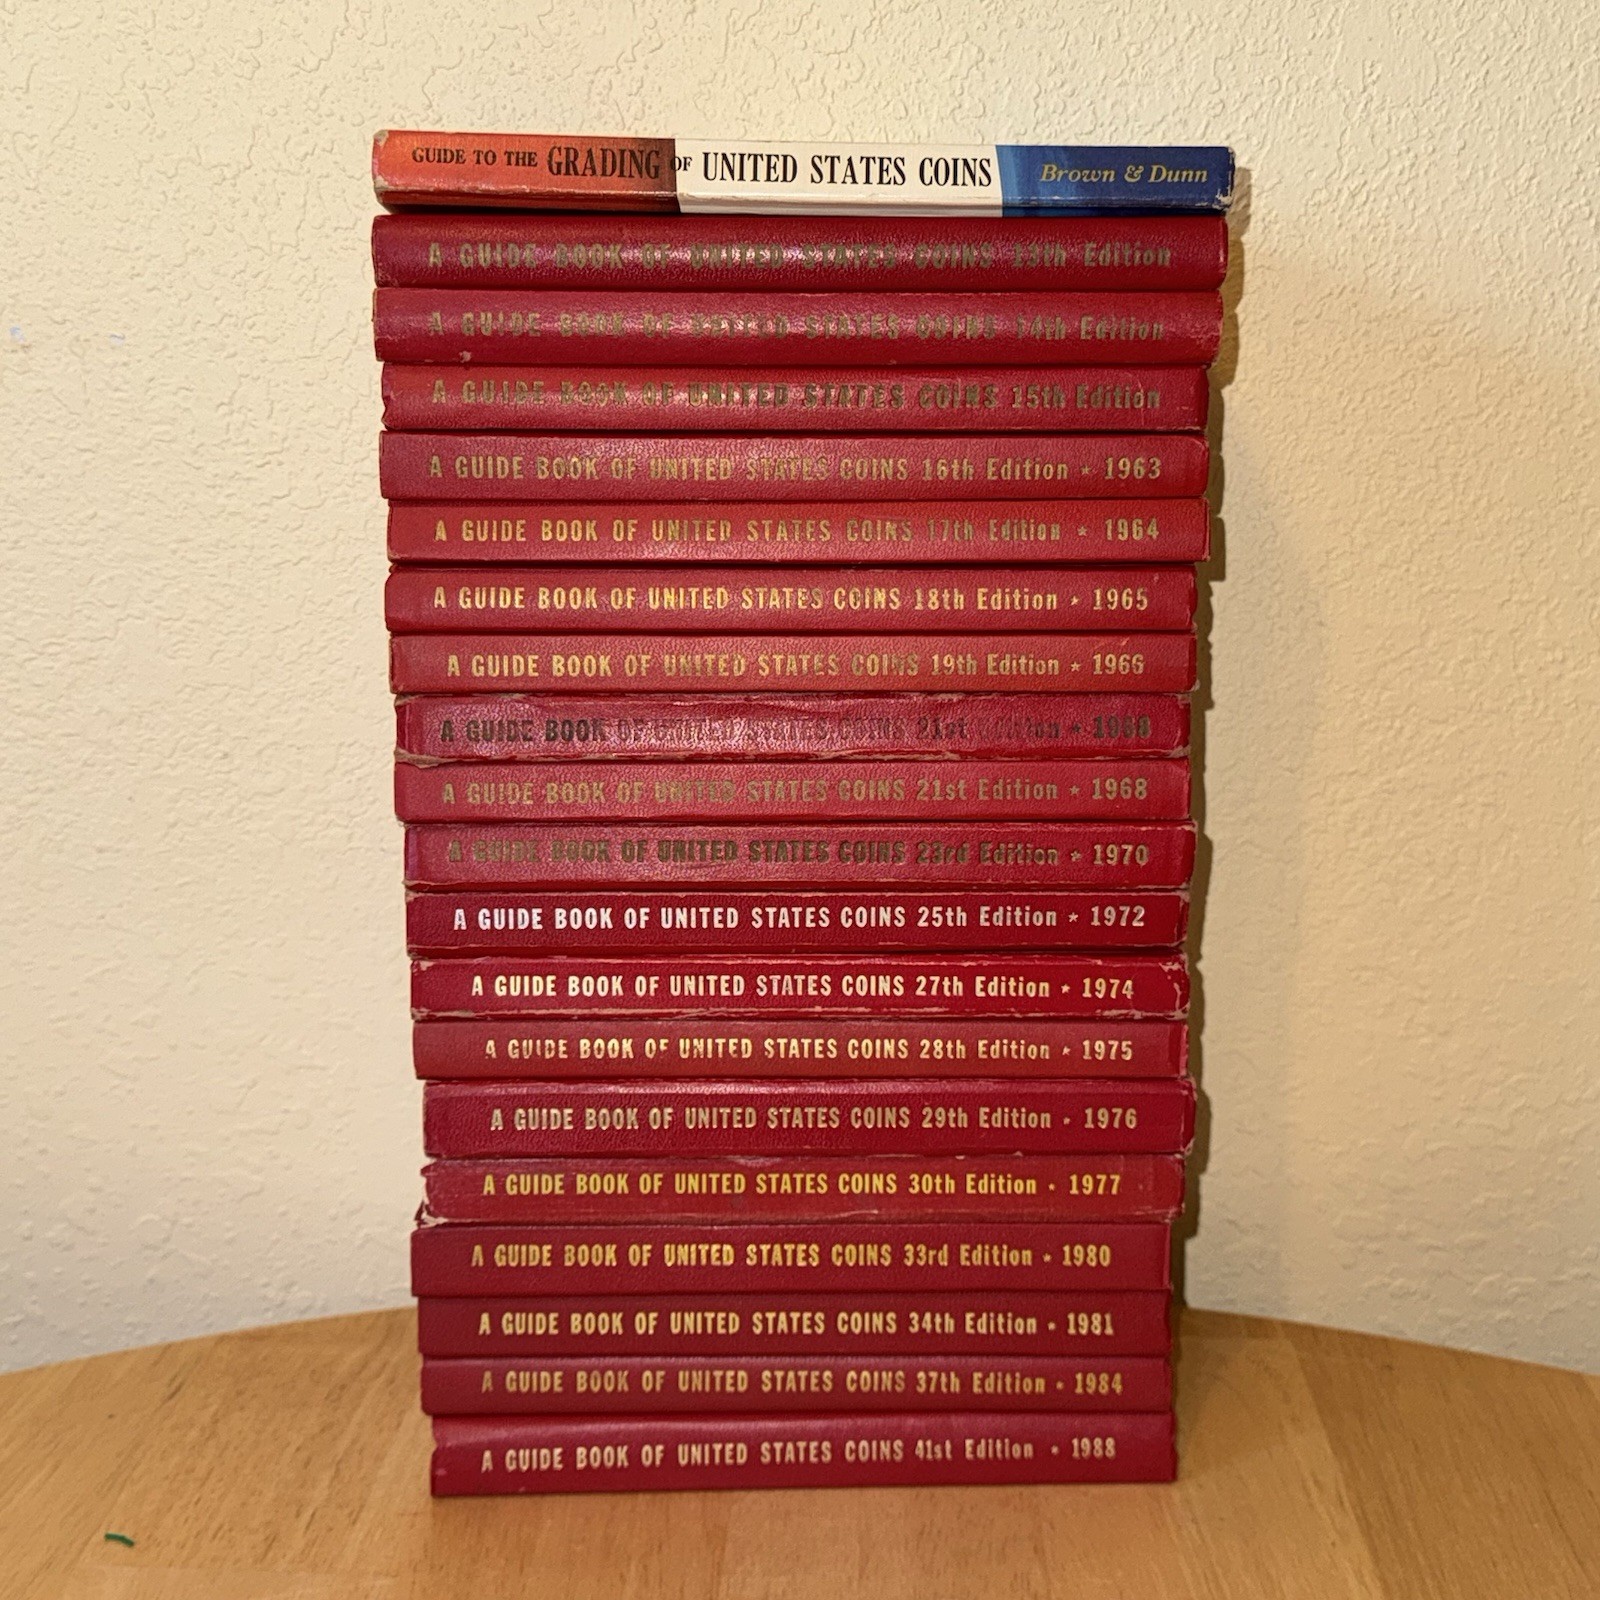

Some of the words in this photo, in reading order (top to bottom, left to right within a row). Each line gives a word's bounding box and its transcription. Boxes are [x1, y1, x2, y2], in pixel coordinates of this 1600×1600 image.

[412, 147, 466, 165] GUIDE
[473, 149, 497, 166] TO
[504, 151, 538, 167] THE
[547, 145, 660, 179] GRADING
[670, 156, 692, 172] OF
[702, 152, 798, 183] UNITED
[810, 154, 906, 186] STATES
[919, 157, 992, 187] COINS
[1040, 164, 1116, 183] Brown
[1124, 165, 1143, 183] &
[1148, 164, 1208, 183] Dunn
[1084, 241, 1172, 268] Edition
[1013, 384, 1066, 410] 15th
[1075, 384, 1162, 410] Edition
[429, 455, 445, 478] A
[454, 455, 524, 481] GUIDE
[839, 457, 909, 482] COINS
[924, 457, 975, 482] 16th
[985, 456, 1070, 481] Edition
[1106, 456, 1163, 482] 1963
[435, 519, 448, 542] A
[461, 518, 526, 543] GUIDE
[541, 519, 600, 543] BOOK
[747, 518, 833, 542] STATES
[926, 518, 976, 544] 17th
[989, 518, 1062, 543] Edition
[1106, 517, 1160, 542] 1964
[434, 586, 447, 609] A
[459, 586, 526, 610] GUIDE
[538, 586, 600, 612] BOOK
[610, 586, 637, 612] OF
[648, 586, 732, 610] UNITED
[741, 586, 825, 610] STATES
[833, 586, 902, 610] COINS
[914, 587, 967, 612] 18th
[976, 586, 1060, 612] Edition
[1094, 586, 1150, 612] 1965
[447, 653, 462, 678] A
[471, 653, 541, 678] GUIDE
[551, 653, 613, 677] BOOK
[624, 652, 653, 678] OF
[757, 652, 841, 677] STATES
[932, 653, 980, 676] 19th
[986, 652, 1062, 678] Edition
[1094, 651, 1146, 676] 1966
[440, 720, 455, 742] A
[545, 718, 605, 742] BOOK
[747, 779, 829, 803] STATES
[838, 778, 906, 802] COINS
[916, 778, 968, 803] 21st
[978, 777, 1059, 802] Edition
[1093, 777, 1148, 801] 1968
[659, 840, 740, 865] UNITED
[749, 839, 830, 864] STATES
[917, 841, 970, 865] 23rd
[980, 841, 1060, 866] Edition
[1094, 843, 1150, 866] 1970
[453, 909, 468, 932] A
[478, 908, 545, 932] GUIDE
[555, 908, 614, 931] BOOK
[624, 907, 652, 931] OF
[661, 907, 740, 930] UNITED
[752, 907, 831, 930] STATES
[840, 906, 907, 930] COINS
[917, 906, 969, 929] 25th
[980, 906, 1058, 928] Edition
[1091, 905, 1147, 928] 1972
[471, 973, 485, 997] A
[494, 974, 558, 997] GUIDE
[568, 975, 626, 997] BOOK
[634, 975, 661, 998] OF
[669, 974, 746, 997] UNITED
[756, 973, 834, 998] STATES
[841, 974, 907, 997] COINS
[916, 973, 966, 997] 27th
[975, 975, 1053, 998] Edition
[1083, 977, 1135, 999] 1974
[507, 1037, 570, 1061] GUIDE
[579, 1037, 636, 1060] BOOK
[678, 1036, 756, 1059] UNITED
[765, 1036, 840, 1059] STATES
[846, 1037, 911, 1059] COINS
[920, 1037, 969, 1062] 28th
[977, 1037, 1052, 1061] Edition
[1083, 1039, 1135, 1063] 1975
[491, 1108, 504, 1131] A
[514, 1106, 575, 1130] GUIDE
[584, 1107, 640, 1130] BOOK
[648, 1106, 675, 1130] OF
[684, 1106, 759, 1130] UNITED
[768, 1105, 841, 1130] STATES
[850, 1106, 911, 1129] COINS
[921, 1105, 971, 1130] 29th
[978, 1106, 1054, 1130] Edition
[1085, 1106, 1139, 1130] 1976
[484, 1173, 497, 1196] A
[505, 1172, 565, 1196] GUIDE
[576, 1172, 631, 1195] BOOK
[638, 1172, 664, 1196] OF
[674, 1171, 749, 1194] UNITED
[757, 1172, 831, 1194] STATES
[838, 1172, 900, 1195] COINS
[910, 1172, 958, 1195] 30th
[966, 1172, 1040, 1196] Edition
[1071, 1172, 1123, 1197] 1977
[472, 1243, 485, 1268] A
[494, 1243, 553, 1267] GUIDE
[564, 1243, 619, 1266] BOOK
[627, 1242, 654, 1267] OF
[664, 1242, 737, 1267] UNITED
[747, 1242, 822, 1266] STATES
[831, 1243, 894, 1266] COINS
[904, 1242, 951, 1267] 33rd
[959, 1243, 1035, 1266] Edition
[1063, 1243, 1113, 1267] 1980
[479, 1312, 492, 1336] A
[502, 1311, 560, 1336] GUIDE
[569, 1311, 626, 1334] BOOK
[634, 1310, 660, 1334] OF
[670, 1310, 742, 1334] UNITED
[752, 1310, 828, 1334] STATES
[836, 1310, 900, 1334] COINS
[909, 1309, 958, 1335] 34th
[965, 1311, 1040, 1335] Edition
[1067, 1311, 1115, 1336] 1981
[505, 1370, 565, 1394] GUIDE
[575, 1370, 631, 1394] BOOK
[640, 1368, 666, 1393] OF
[678, 1369, 750, 1393] UNITED
[761, 1369, 836, 1394] STATES
[845, 1368, 906, 1393] COINS
[917, 1370, 963, 1394] 37th
[972, 1371, 1049, 1395] Edition
[1076, 1371, 1125, 1395] 1984
[482, 1449, 494, 1472] A
[504, 1445, 565, 1473] GUIDE
[576, 1444, 630, 1470] BOOK
[640, 1444, 666, 1468] OF
[676, 1440, 750, 1467] UNITED
[760, 1440, 835, 1465] STATES
[844, 1439, 906, 1463] COINS
[916, 1439, 955, 1462] 41st
[965, 1437, 1036, 1462] Edition
[1072, 1436, 1118, 1461] 1988
